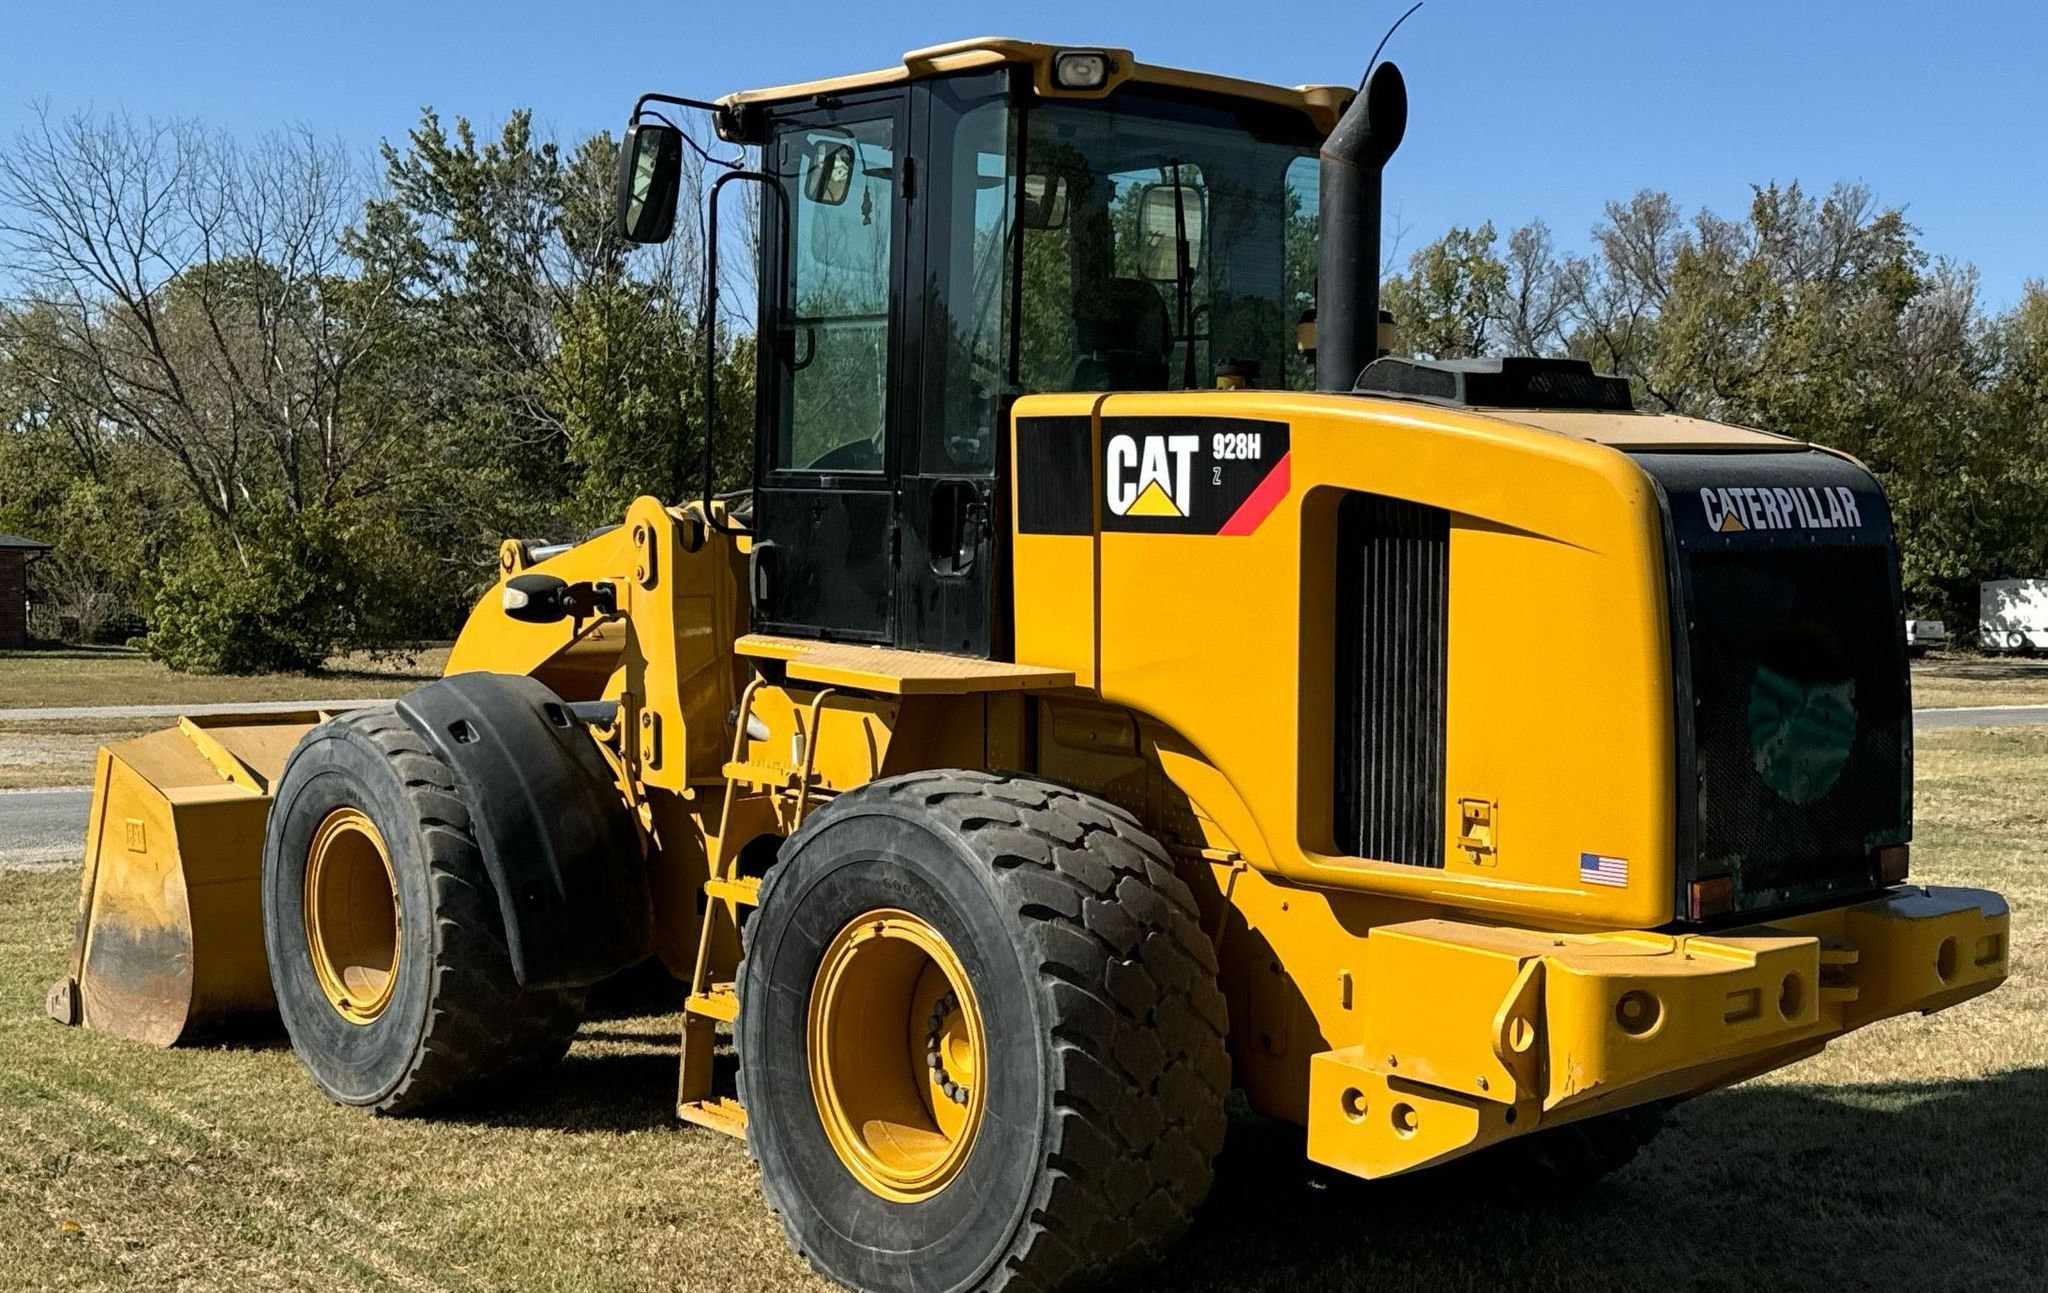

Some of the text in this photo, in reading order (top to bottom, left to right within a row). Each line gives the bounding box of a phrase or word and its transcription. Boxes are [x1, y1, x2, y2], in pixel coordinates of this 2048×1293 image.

[1213, 433, 1261, 460] 928H
[1106, 434, 1199, 517] CAT
[1212, 466, 1222, 486] Z
[1700, 486, 1862, 533] CATERPILLAR
